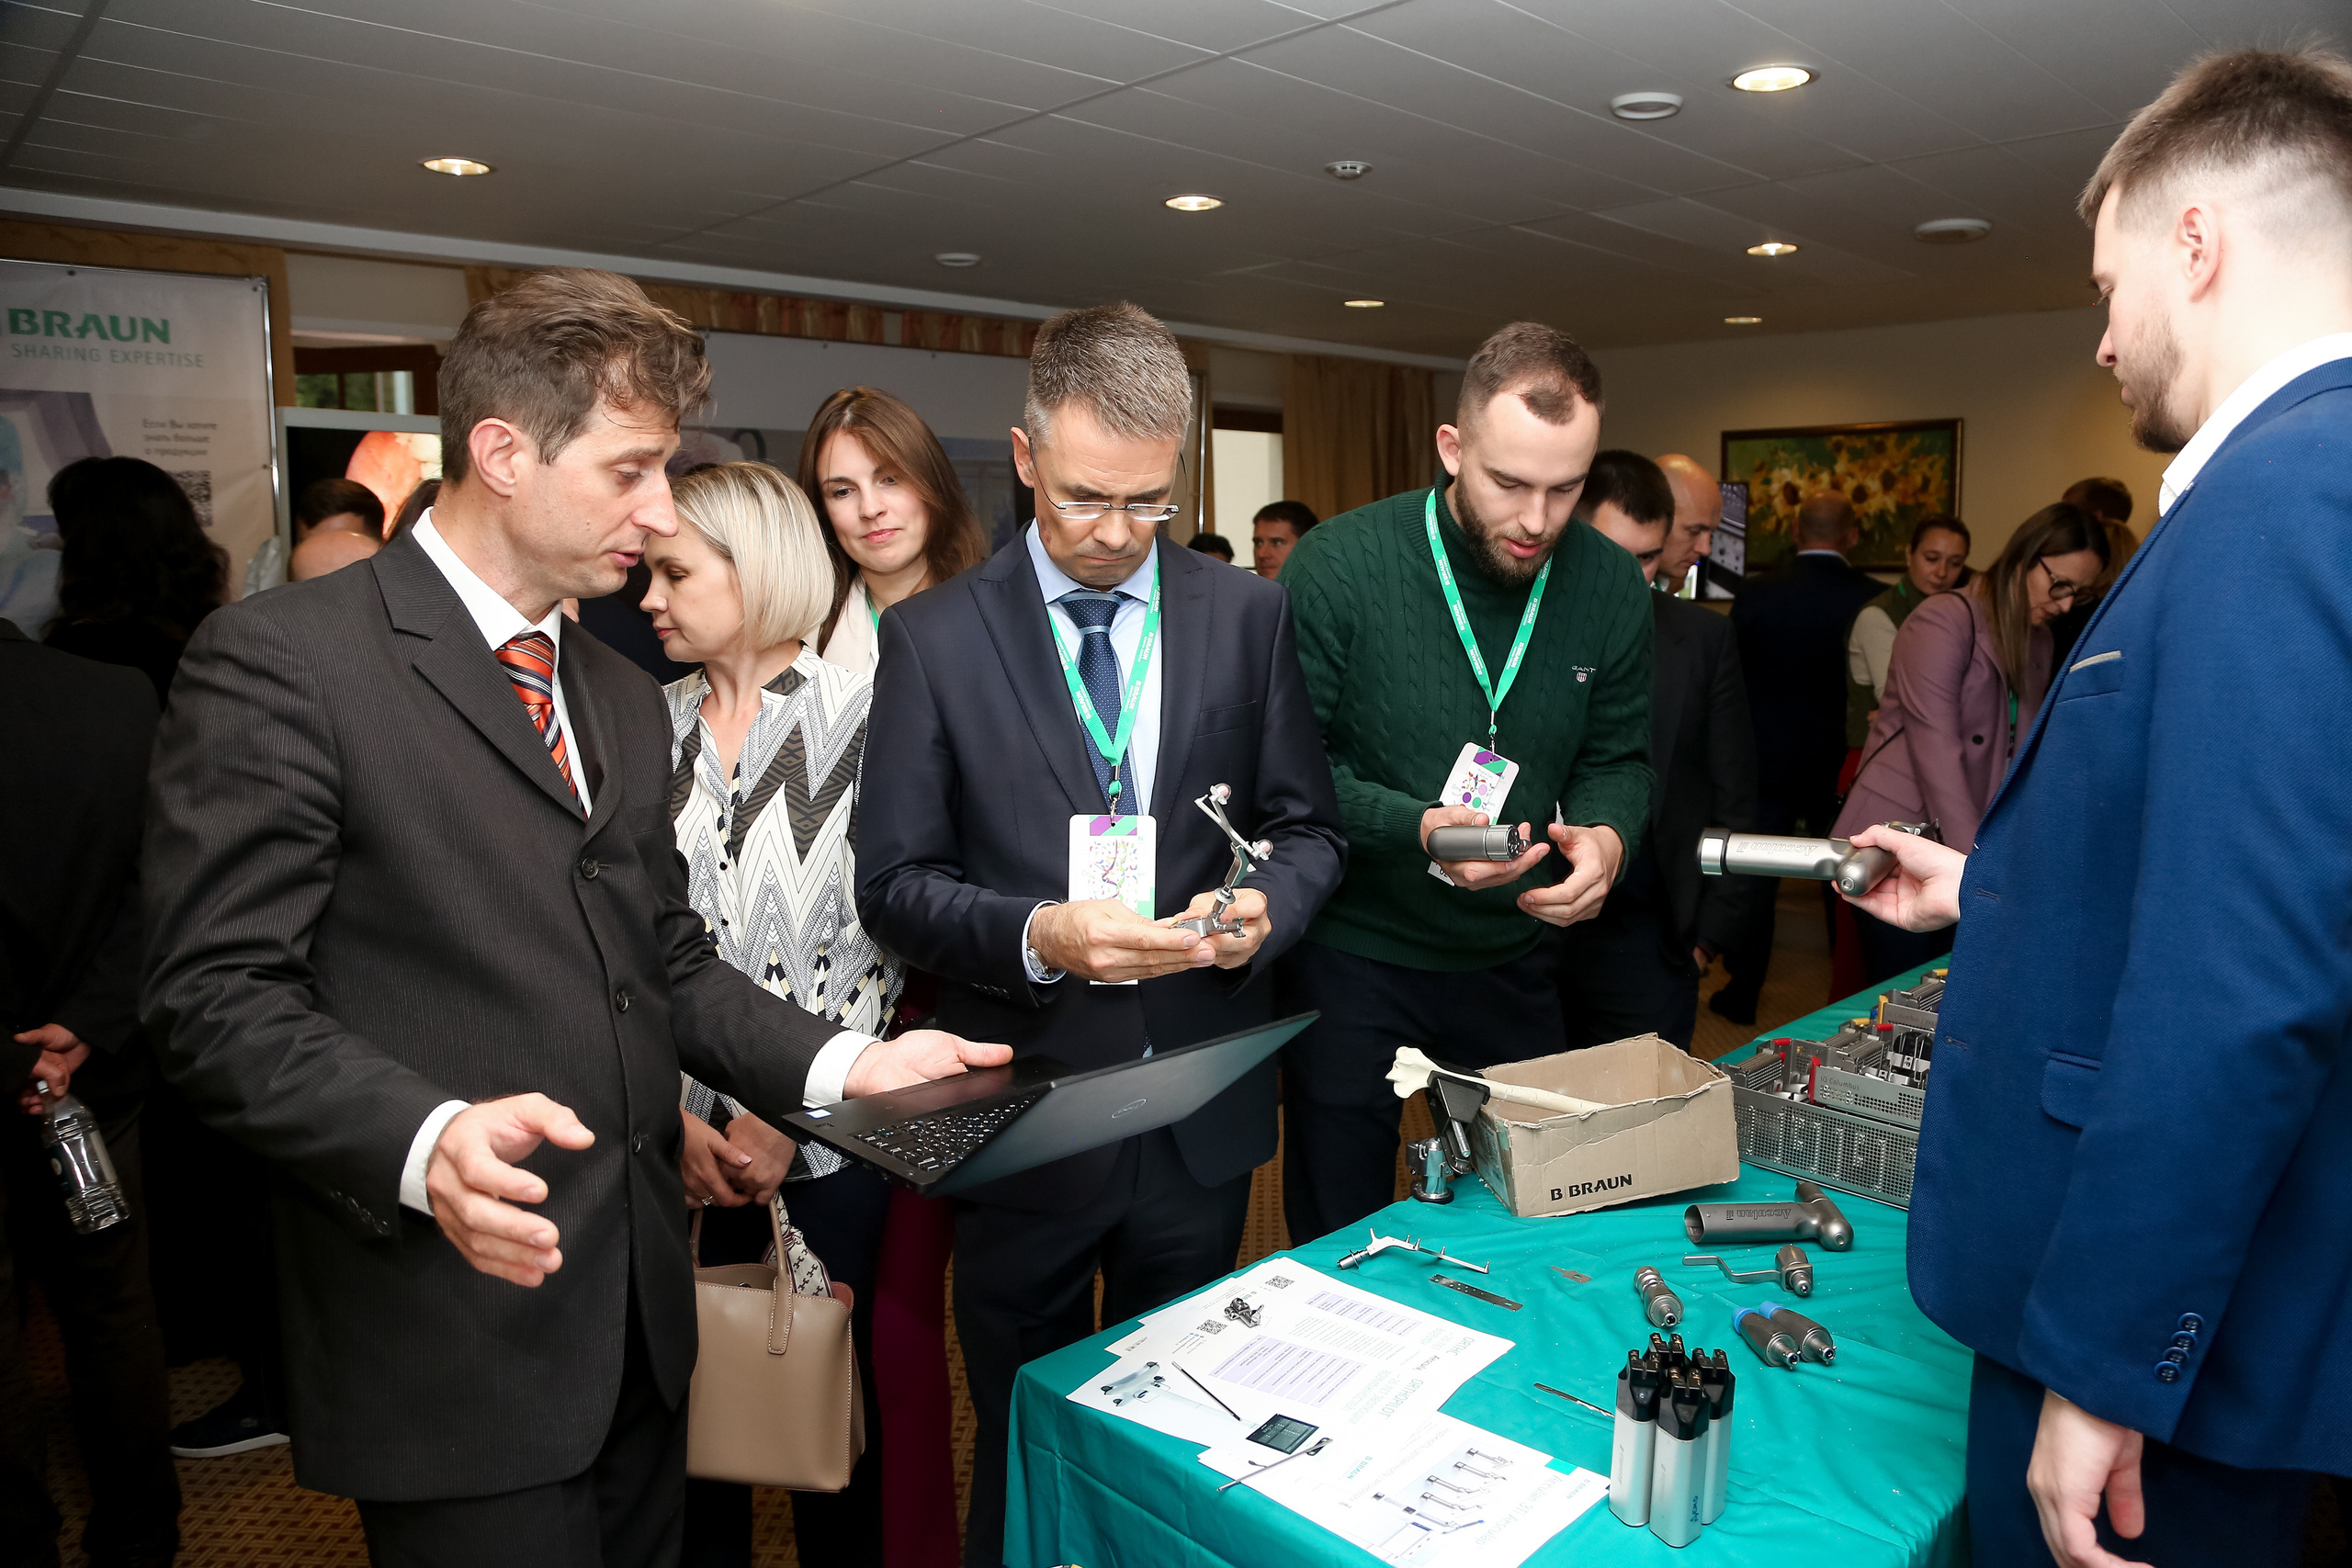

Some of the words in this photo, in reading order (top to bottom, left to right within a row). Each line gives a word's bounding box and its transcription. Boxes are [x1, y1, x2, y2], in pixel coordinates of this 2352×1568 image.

[7, 308, 171, 344] BRAUN
[11, 343, 101, 364] SHARING
[109, 348, 204, 368] EXPERTISE
[1750, 841, 1817, 856] Acculan
[1829, 1077, 1860, 1090] Columbus
[1568, 1174, 1633, 1198] BRAUN
[1736, 1208, 1791, 1220] Acculan
[1411, 1354, 1441, 1372] Aescula
[1525, 1473, 1563, 1503] Acculan
